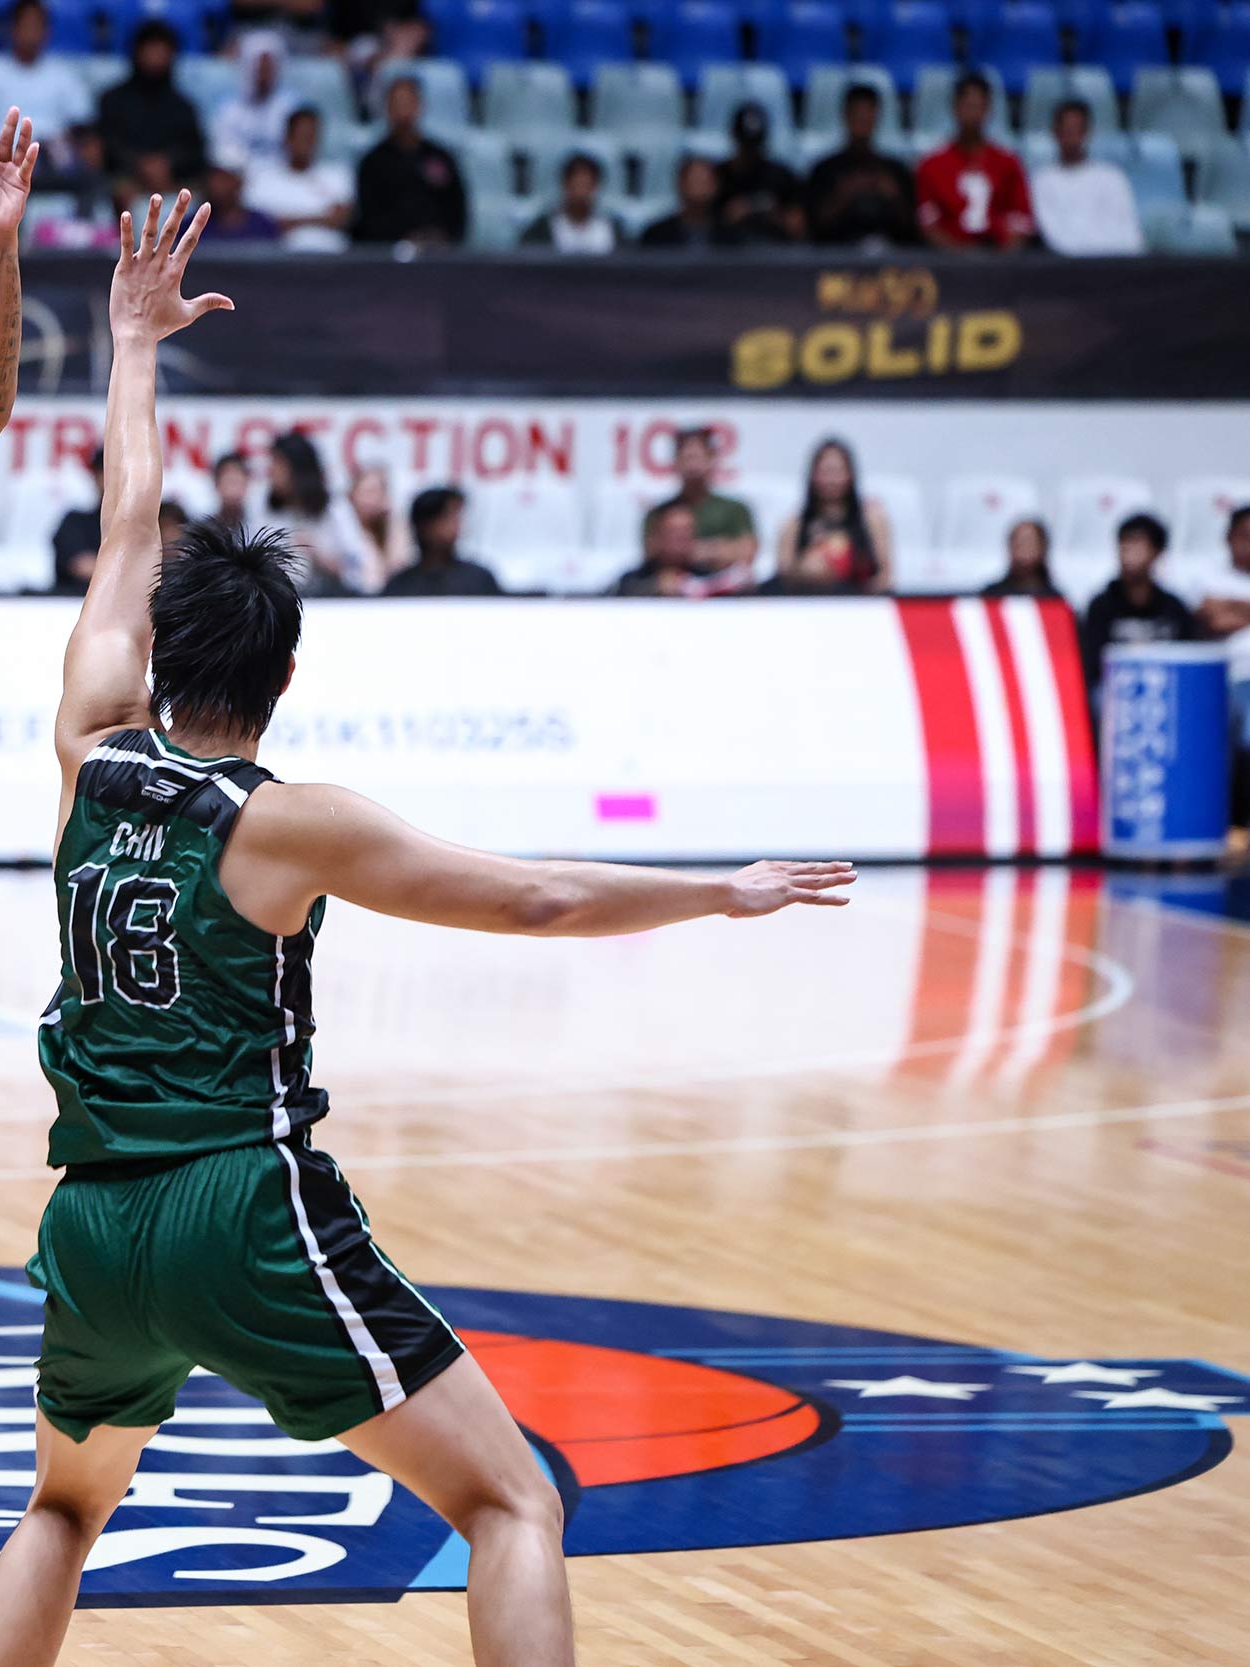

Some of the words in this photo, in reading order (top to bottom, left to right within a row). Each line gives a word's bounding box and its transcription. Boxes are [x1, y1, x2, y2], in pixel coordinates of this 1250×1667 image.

[731, 309, 1020, 390] SOLID
[236, 415, 573, 481] SCTION
[67, 861, 181, 1010] 18
